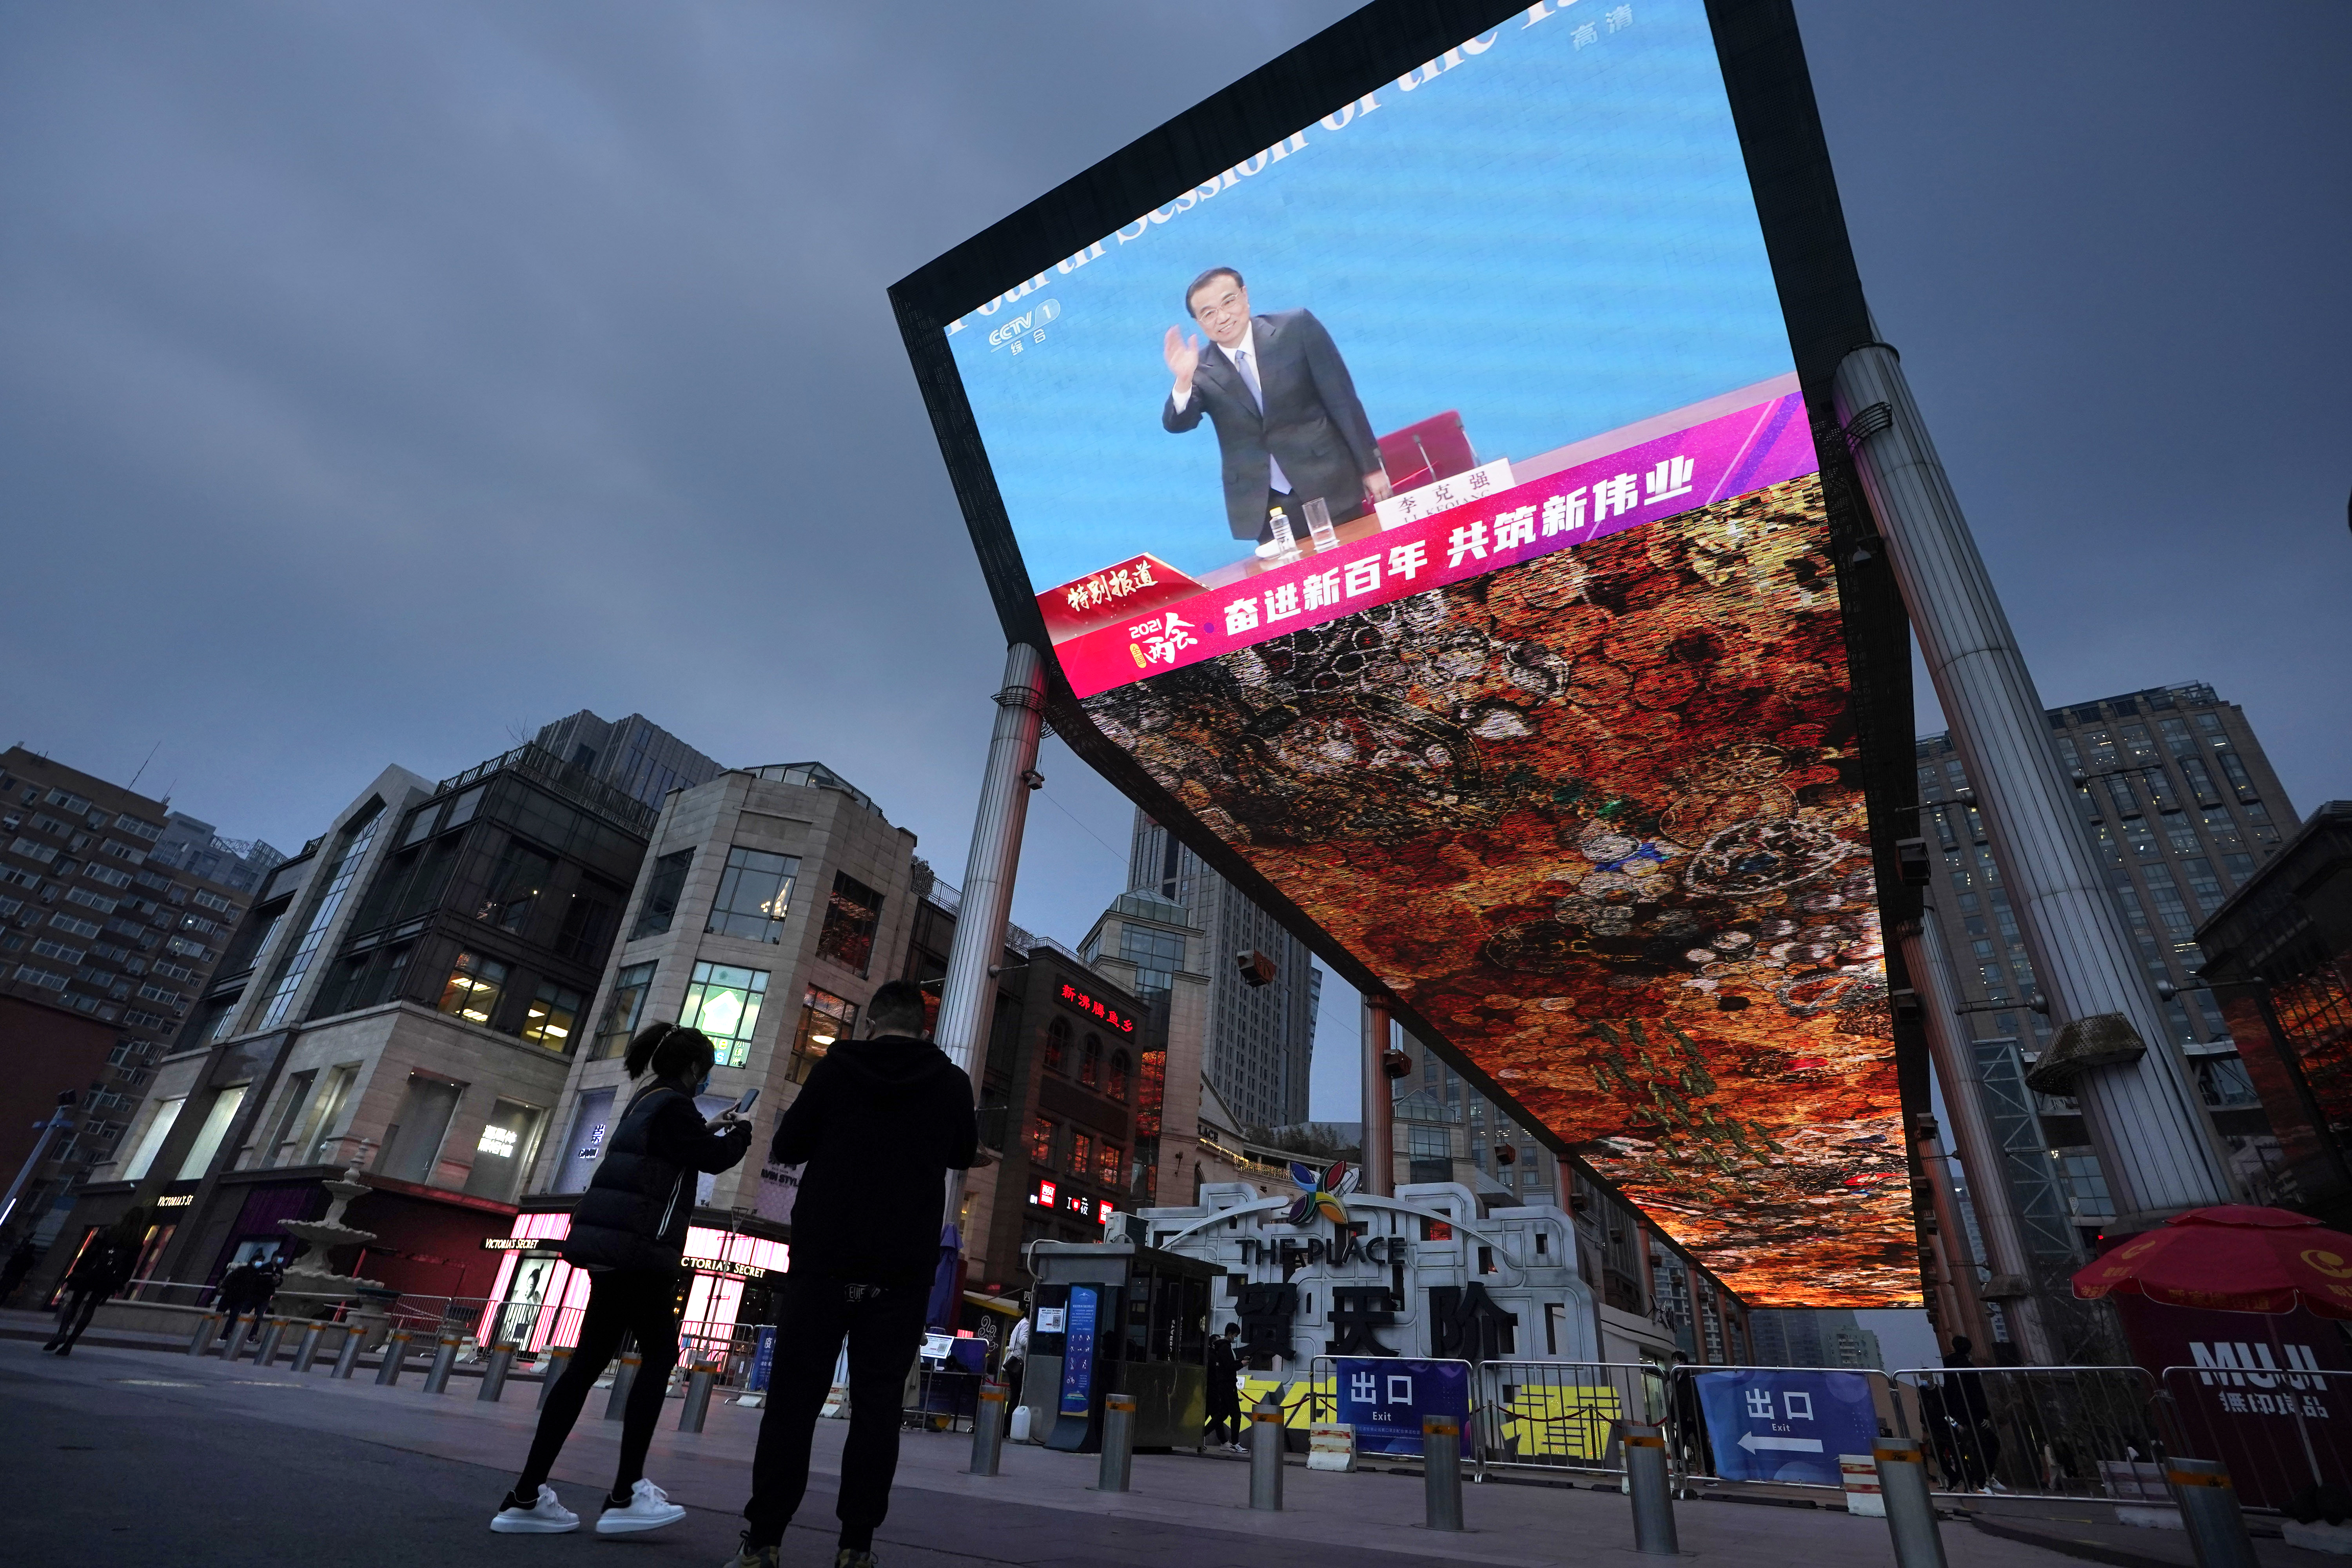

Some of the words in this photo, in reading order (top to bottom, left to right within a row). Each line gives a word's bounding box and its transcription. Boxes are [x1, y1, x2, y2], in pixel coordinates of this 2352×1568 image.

[1570, 4, 1633, 52] 高清
[989, 310, 1032, 345] CCTV
[1011, 329, 1046, 356] 综合
[1398, 471, 1490, 514] 李克强
[1225, 544, 1428, 636] 奋进新百年
[1447, 455, 1695, 568] 共筑新伟业
[1067, 560, 1158, 612] 特别报道
[1129, 618, 1163, 639] 2021
[1142, 612, 1198, 664] 两会
[1131, 646, 1145, 665] 全国
[1061, 984, 1133, 1032] 新沸腾鱼乡
[157, 1196, 187, 1207] VICTORIA'S
[485, 1238, 516, 1249] VICTORIA'S
[516, 1238, 539, 1249] SECRET
[1235, 1238, 1297, 1265] THE
[1307, 1236, 1406, 1265] PLACE
[733, 1263, 766, 1278] SECRET
[2189, 1341, 2328, 1391] MUJI
[1351, 1372, 1412, 1405] 出口
[1745, 1388, 1814, 1421] 出口
[1372, 1411, 1392, 1421] Exit
[1772, 1423, 1791, 1432] Exit
